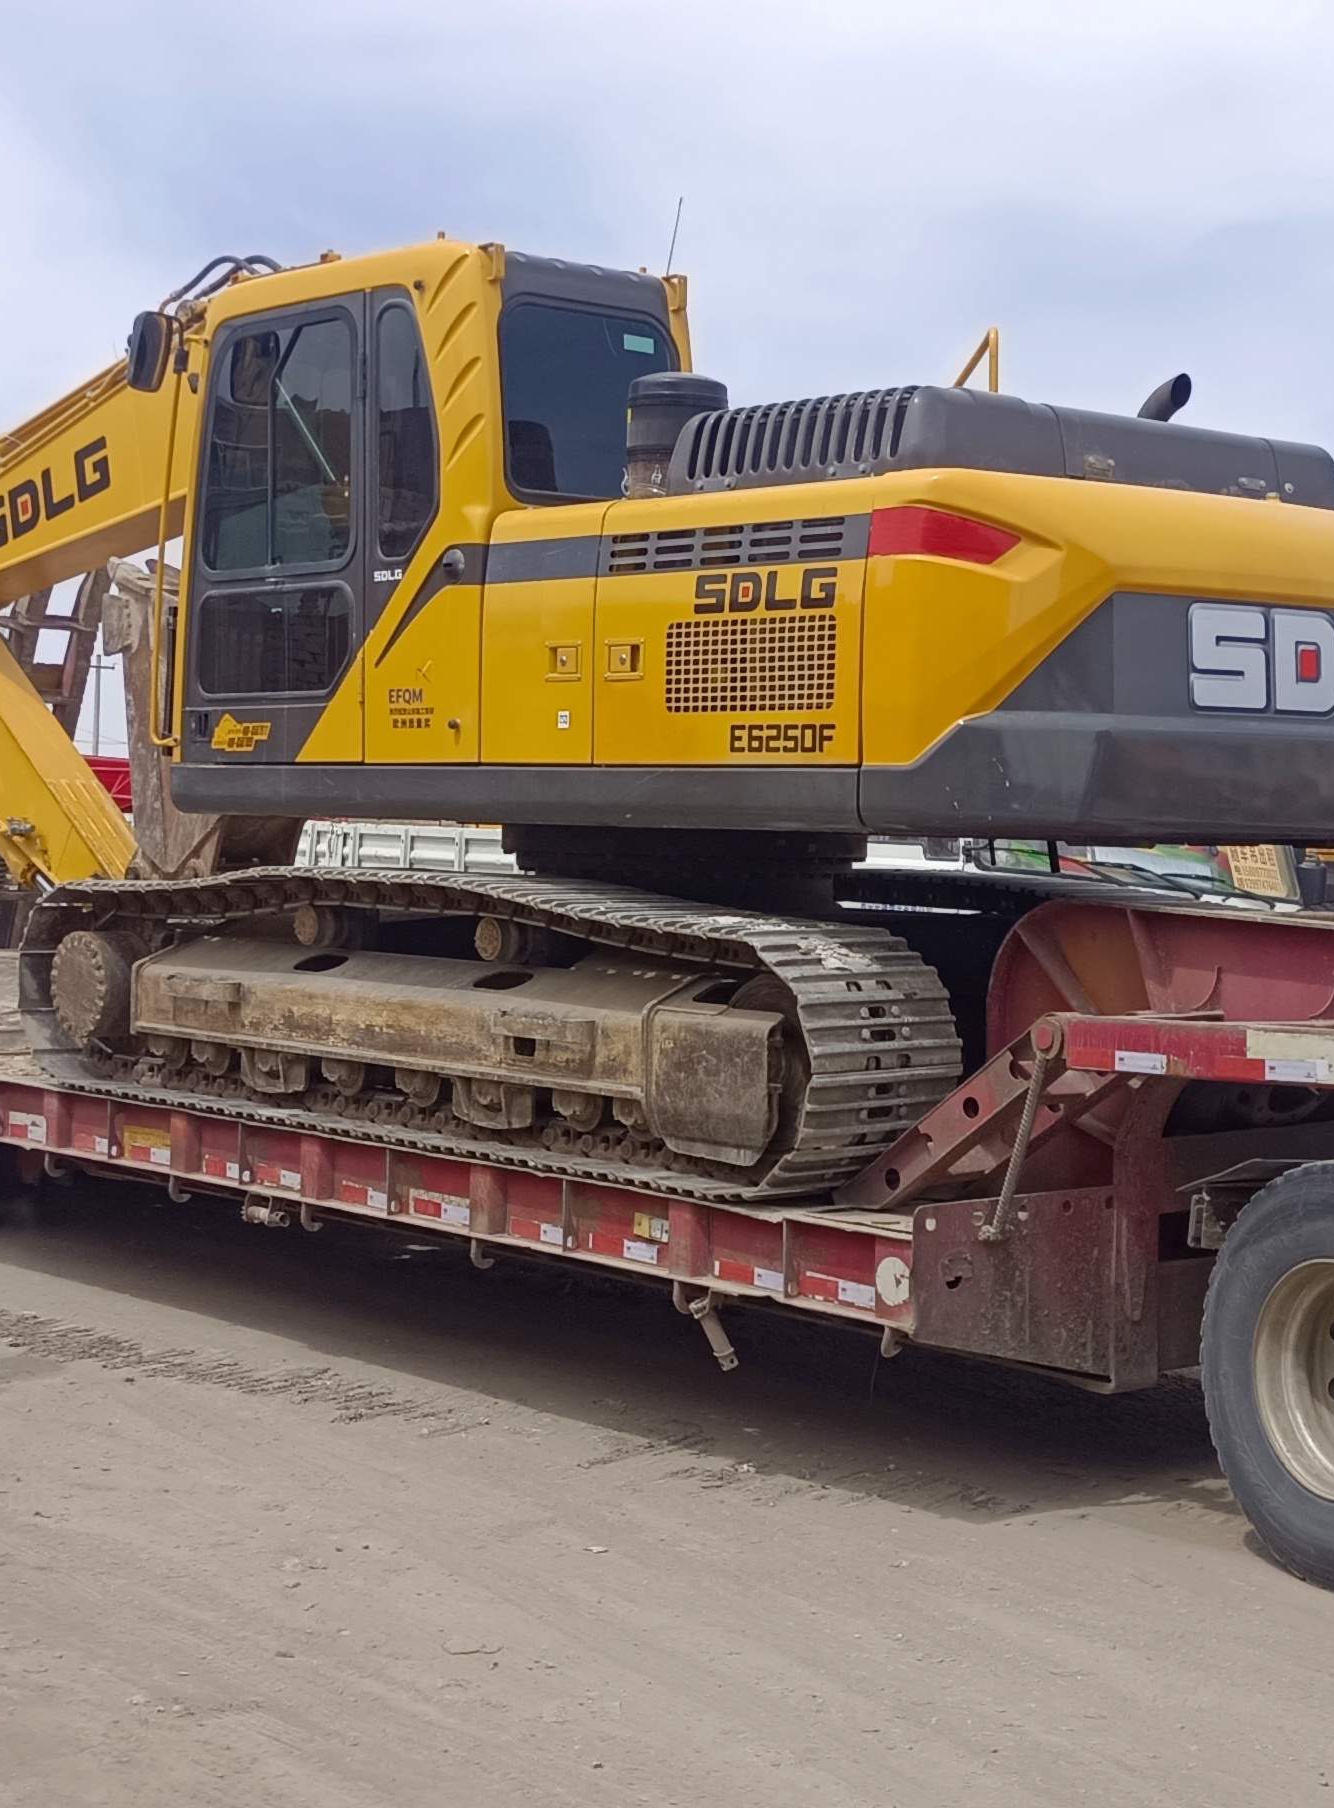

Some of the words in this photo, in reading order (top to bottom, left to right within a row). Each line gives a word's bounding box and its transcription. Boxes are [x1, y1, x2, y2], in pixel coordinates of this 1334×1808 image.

[373, 569, 402, 582] SDLG
[694, 566, 837, 614] SDLG
[388, 688, 423, 705] EFQM
[730, 723, 836, 753] E6250F
